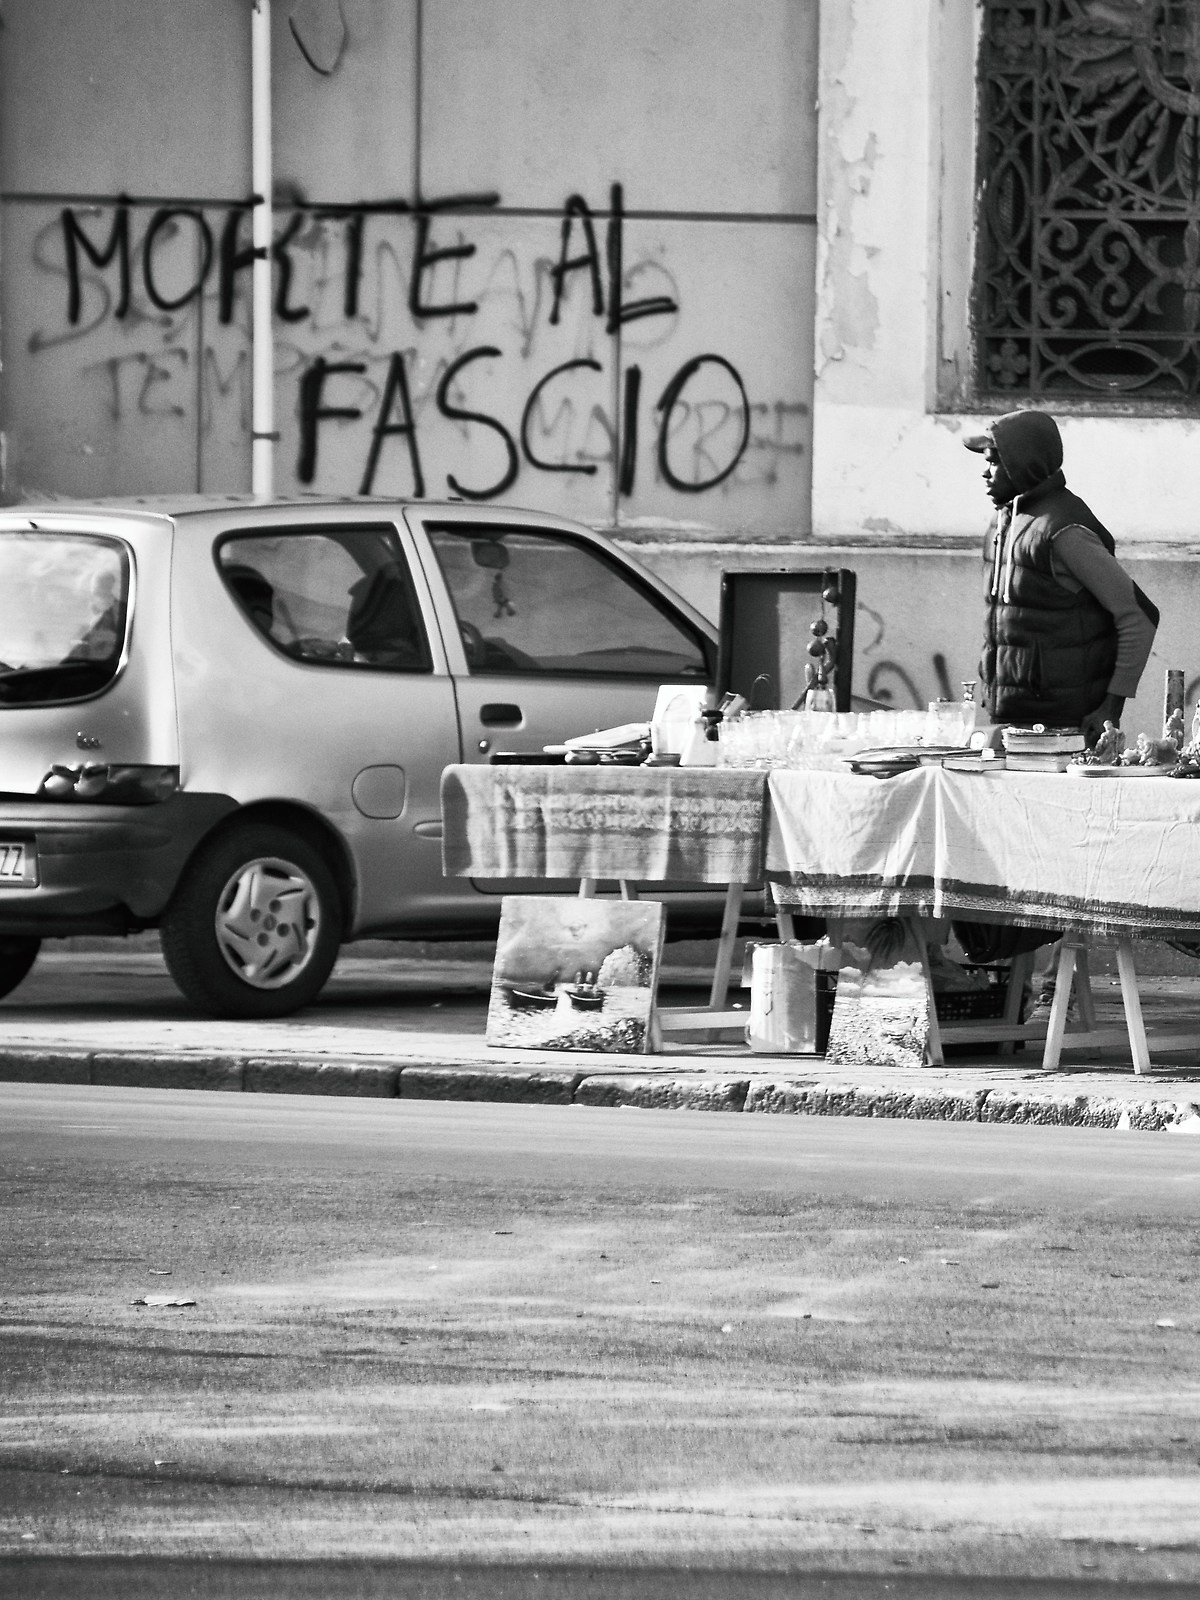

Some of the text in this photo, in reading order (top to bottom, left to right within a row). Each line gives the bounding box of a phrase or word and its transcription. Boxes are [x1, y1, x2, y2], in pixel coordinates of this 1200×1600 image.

[61, 190, 499, 328] MORTE
[551, 182, 680, 334] AL
[298, 346, 752, 500] FASCIO
